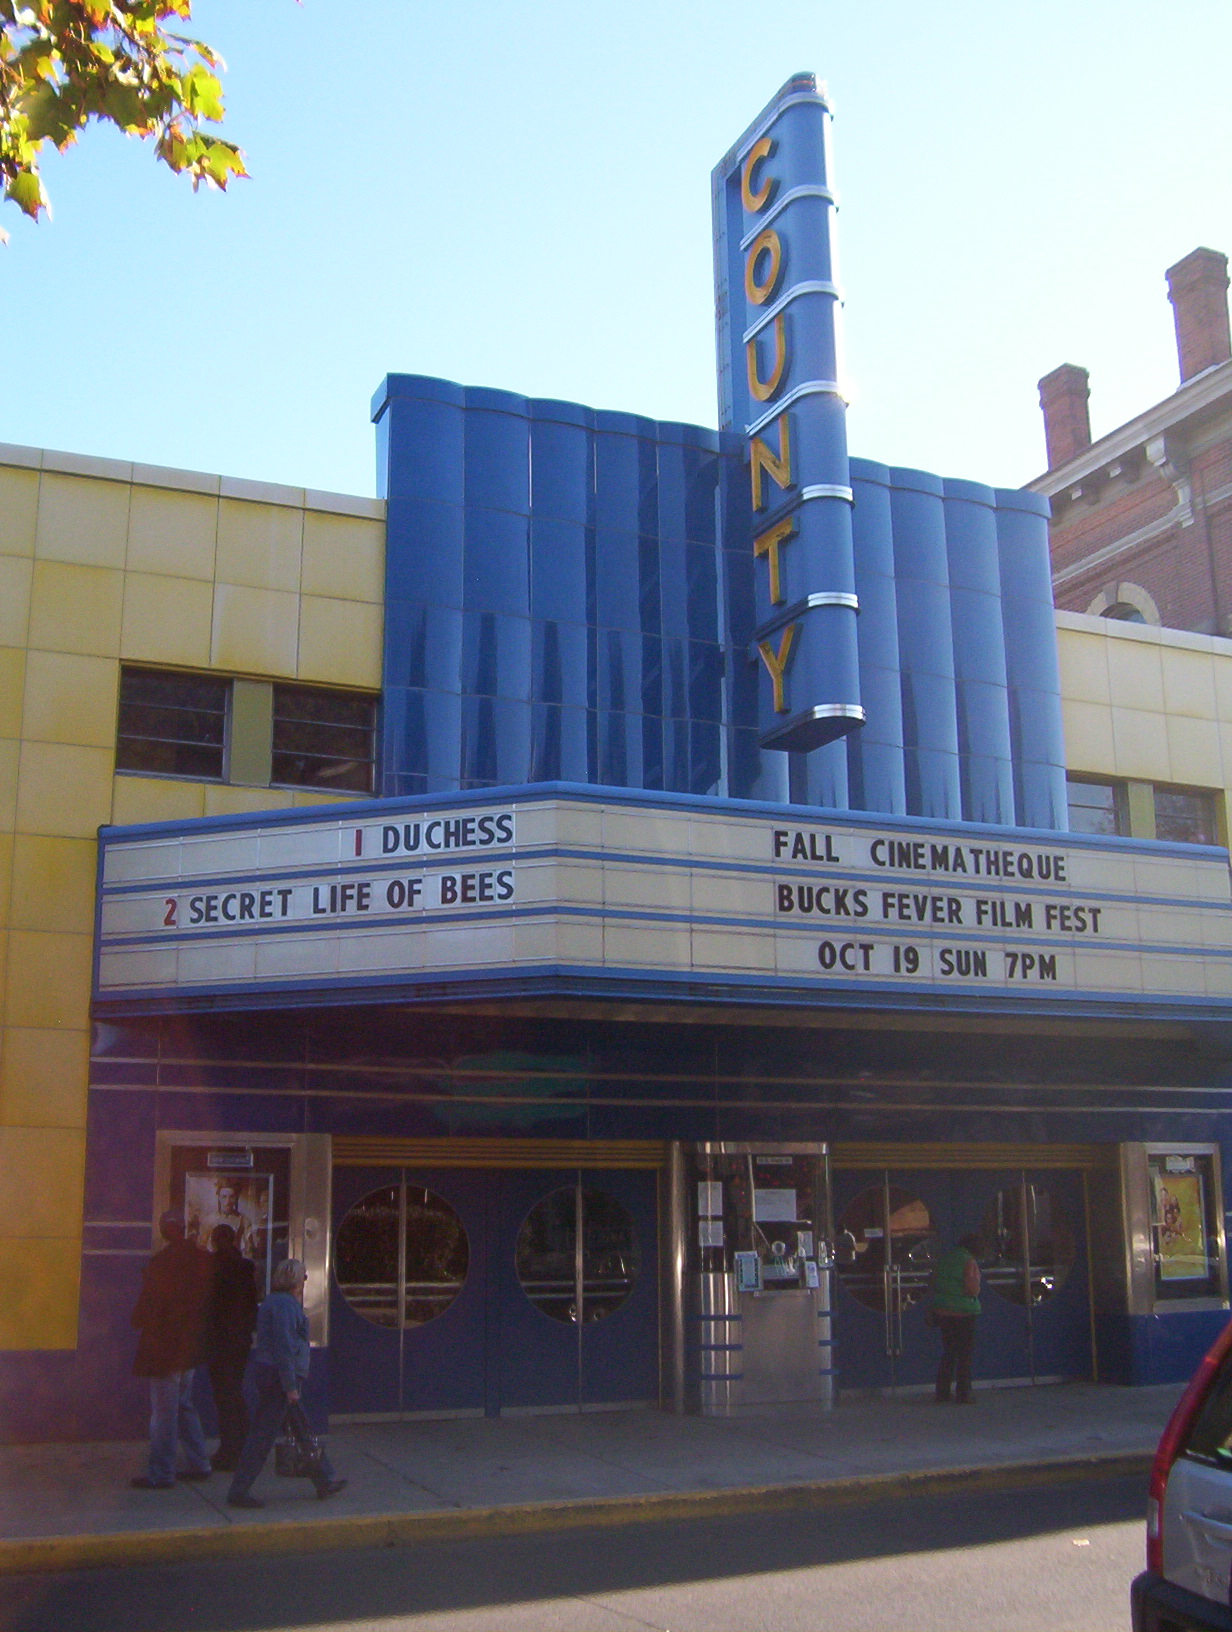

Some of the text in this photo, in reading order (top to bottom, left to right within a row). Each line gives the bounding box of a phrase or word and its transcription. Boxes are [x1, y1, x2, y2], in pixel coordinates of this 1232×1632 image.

[741, 137, 797, 713] COUNTY
[382, 814, 513, 854] DUCHESS
[774, 831, 1066, 881] FALL CINEMATHEQUE
[164, 871, 514, 926] 2 SECRET LIFE OF BEES
[778, 885, 1102, 933] BUCKS FEVER FILM FEST
[818, 941, 1057, 980] OCT 19 SUN 7PM
